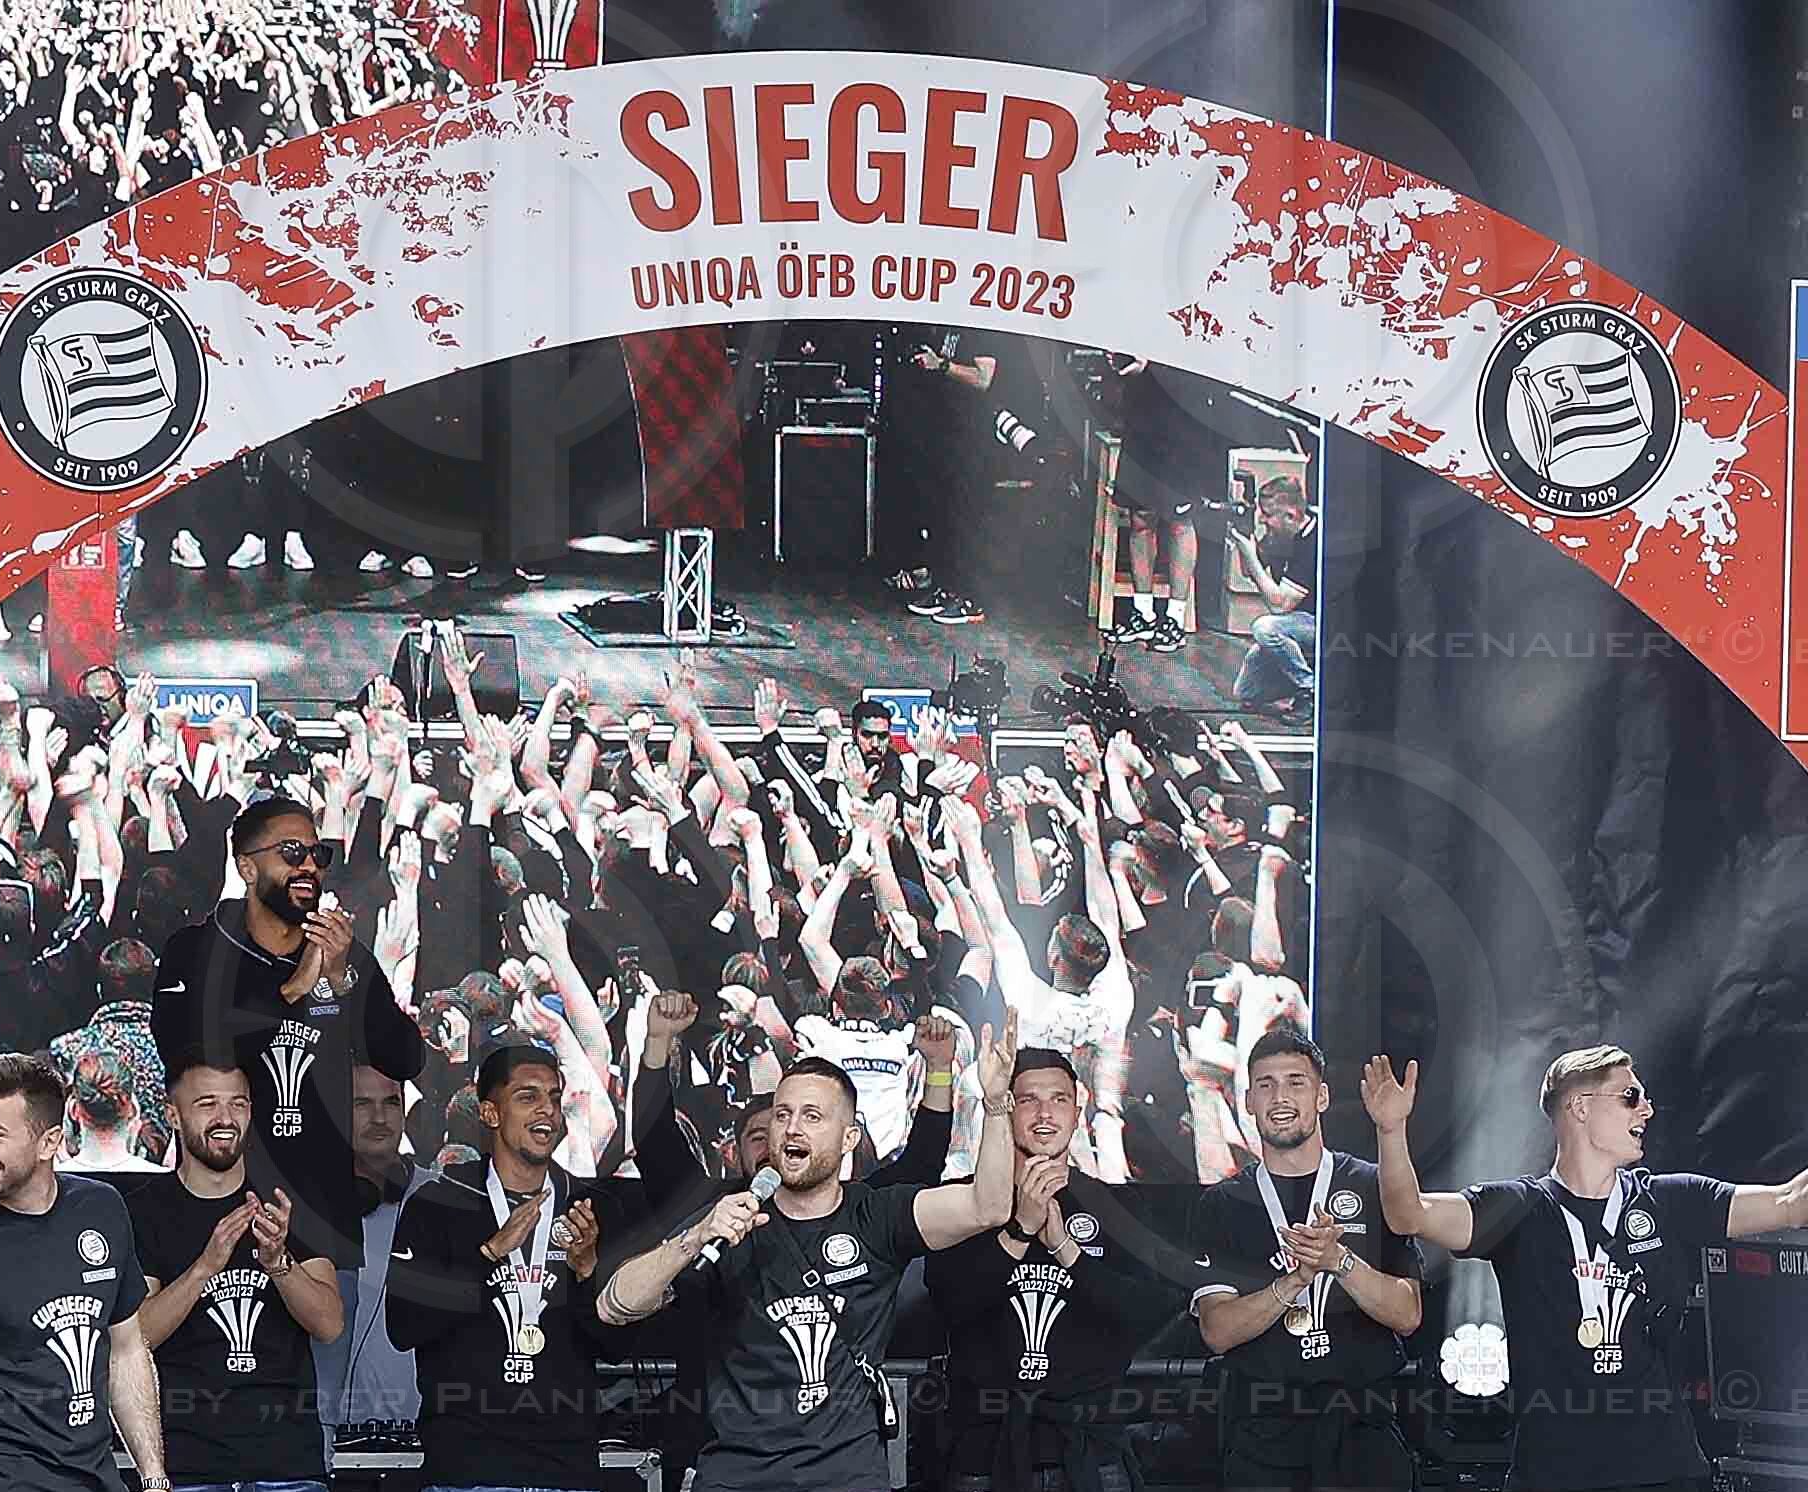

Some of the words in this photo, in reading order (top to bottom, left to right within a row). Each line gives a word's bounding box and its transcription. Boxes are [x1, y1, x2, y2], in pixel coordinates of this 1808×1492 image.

[619, 83, 1079, 242] SIEGER
[631, 256, 762, 310] UNIQA
[777, 242, 856, 299] ÖFB
[872, 254, 958, 304] CUP
[969, 263, 1076, 320] 2023
[31, 295, 55, 319] SK
[57, 281, 118, 301] STURM
[124, 287, 171, 325] GRAZ
[1515, 329, 1538, 351] SK
[1540, 313, 1597, 335] STURM
[1603, 319, 1647, 355] GRAZ
[53, 457, 91, 481] SEIT
[99, 460, 139, 481] 1909
[1537, 485, 1573, 507] SEIT
[1580, 486, 1618, 508] 1909
[272, 1125, 302, 1137] CUP
[212, 1285, 254, 1302] 2022/23
[1018, 1281, 1059, 1294] 2022/23
[31, 1295, 103, 1330] CUPSIEGER
[785, 1312, 830, 1327] 2022/23
[1301, 1346, 1331, 1360] CUP
[1018, 1370, 1048, 1381] CUP
[1593, 1362, 1623, 1374] CUP
[504, 1371, 534, 1384] CUP
[68, 1412, 94, 1426] CUP
